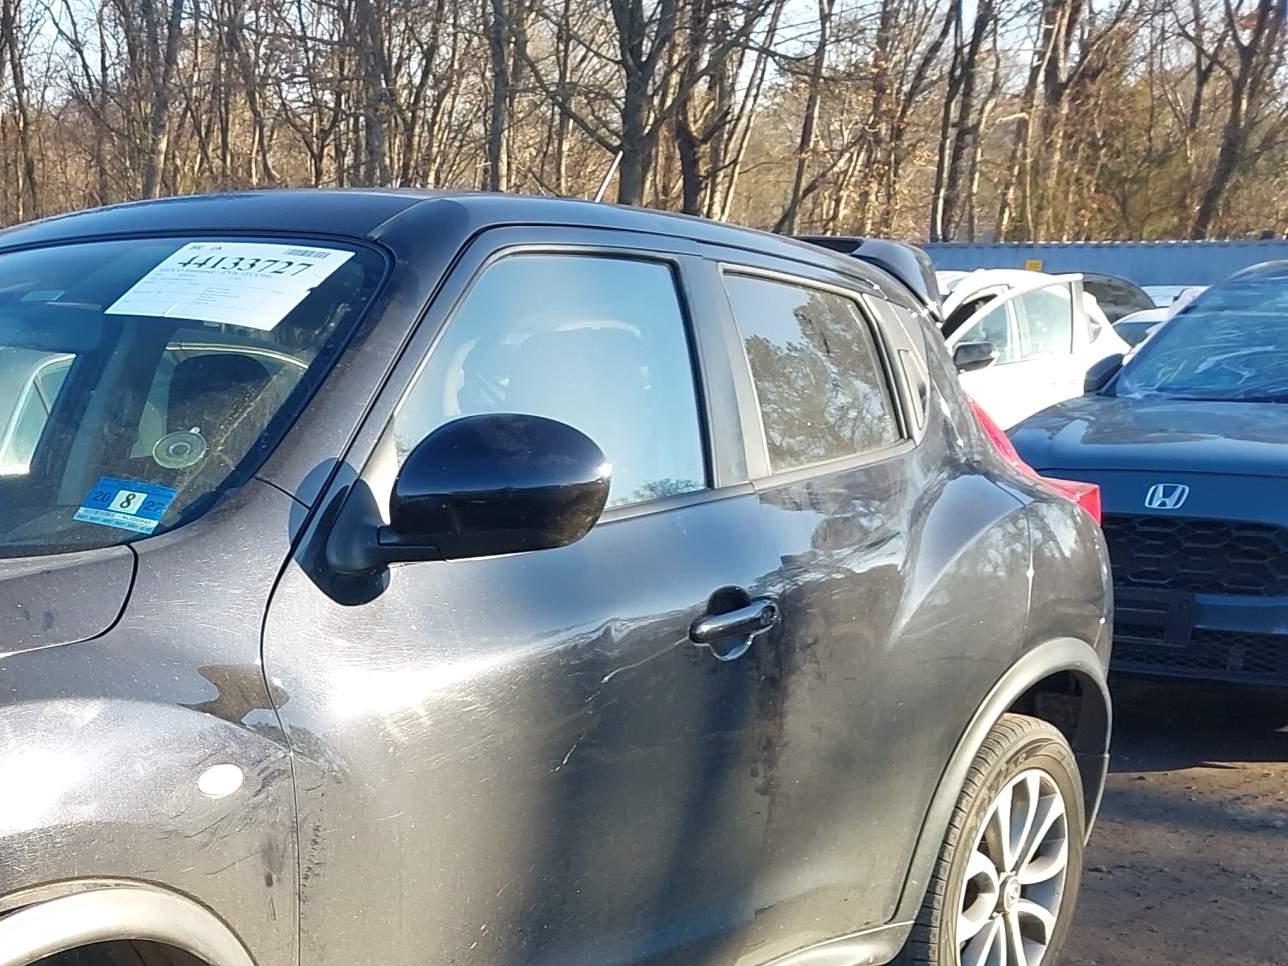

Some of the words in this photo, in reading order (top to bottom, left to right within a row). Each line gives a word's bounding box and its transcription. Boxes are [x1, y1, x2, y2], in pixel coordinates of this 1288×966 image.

[177, 255, 315, 276] 44133727
[92, 490, 112, 503] 20
[119, 493, 136, 508] 8
